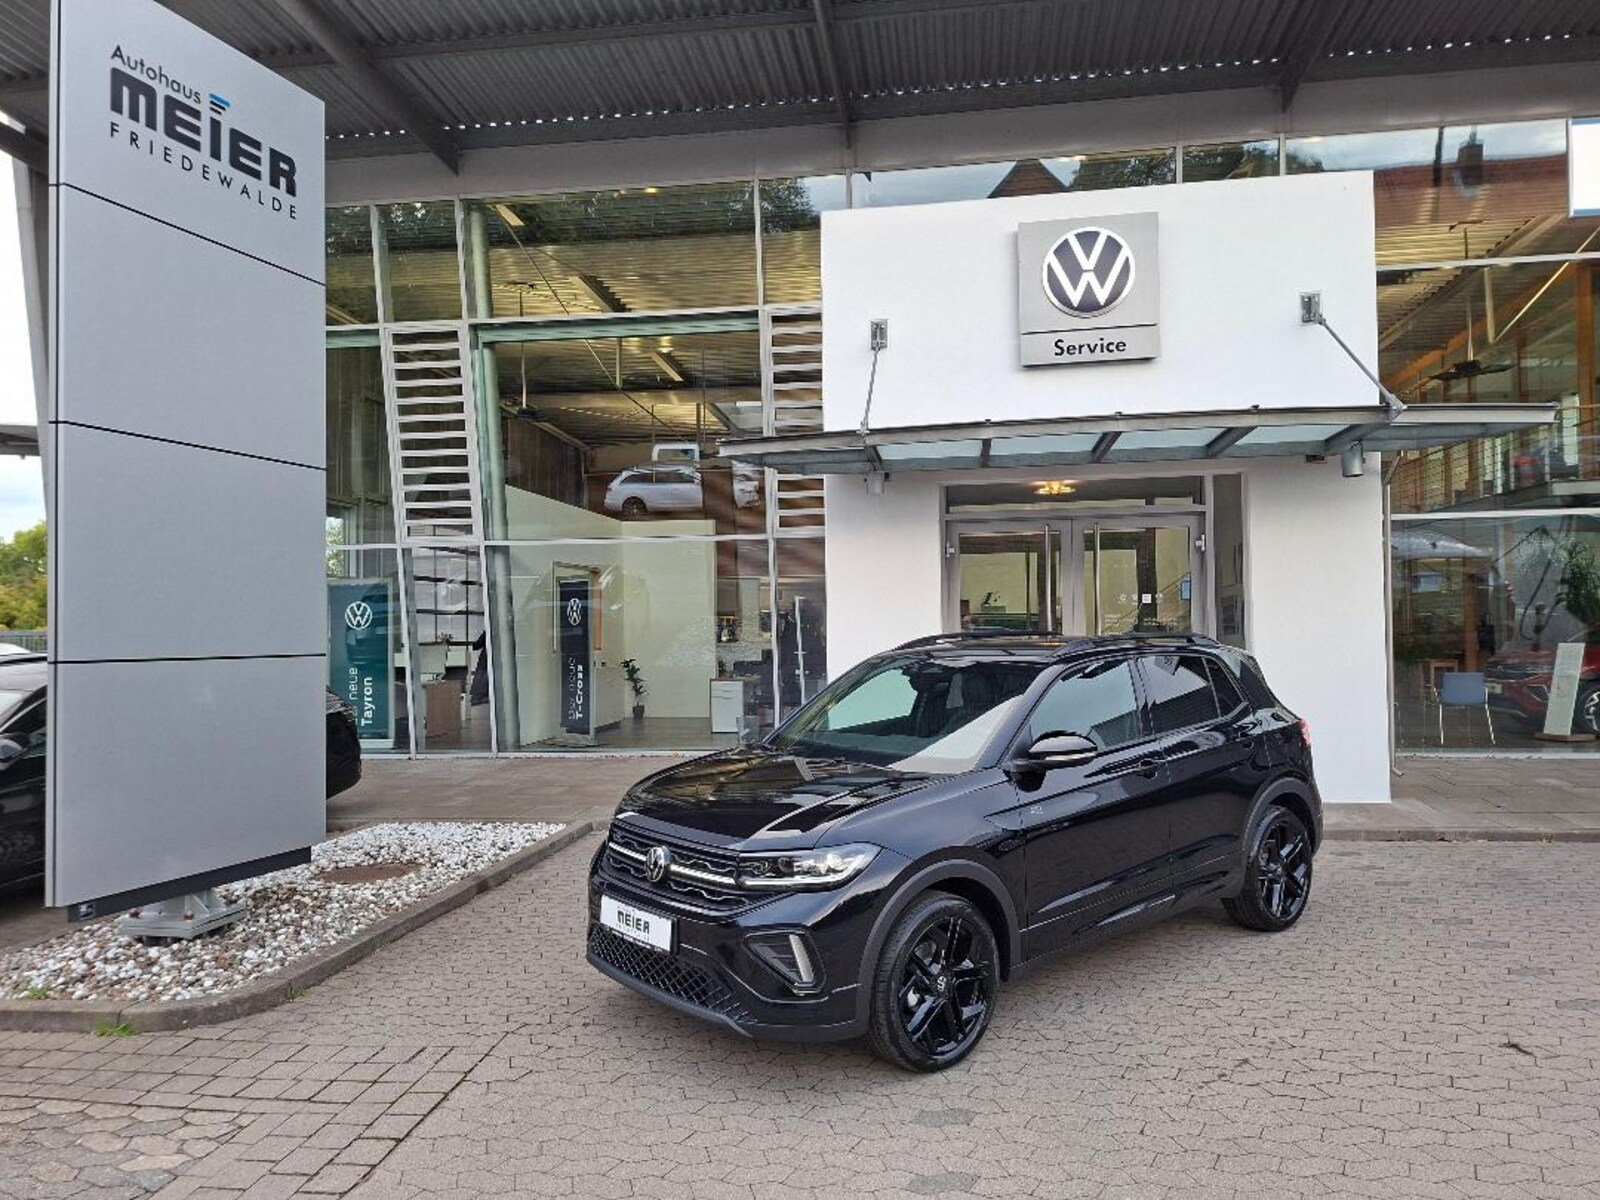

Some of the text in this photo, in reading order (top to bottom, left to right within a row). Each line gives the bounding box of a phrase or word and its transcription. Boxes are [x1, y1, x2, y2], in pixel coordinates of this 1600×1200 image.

[111, 45, 202, 104] Autohaus
[110, 121, 297, 220] FRIEDEWALDE
[1054, 337, 1127, 356] Service
[348, 667, 358, 701] neue
[361, 677, 376, 727] Tayron
[575, 664, 584, 720] T-Cross
[617, 909, 650, 935] MEIER
